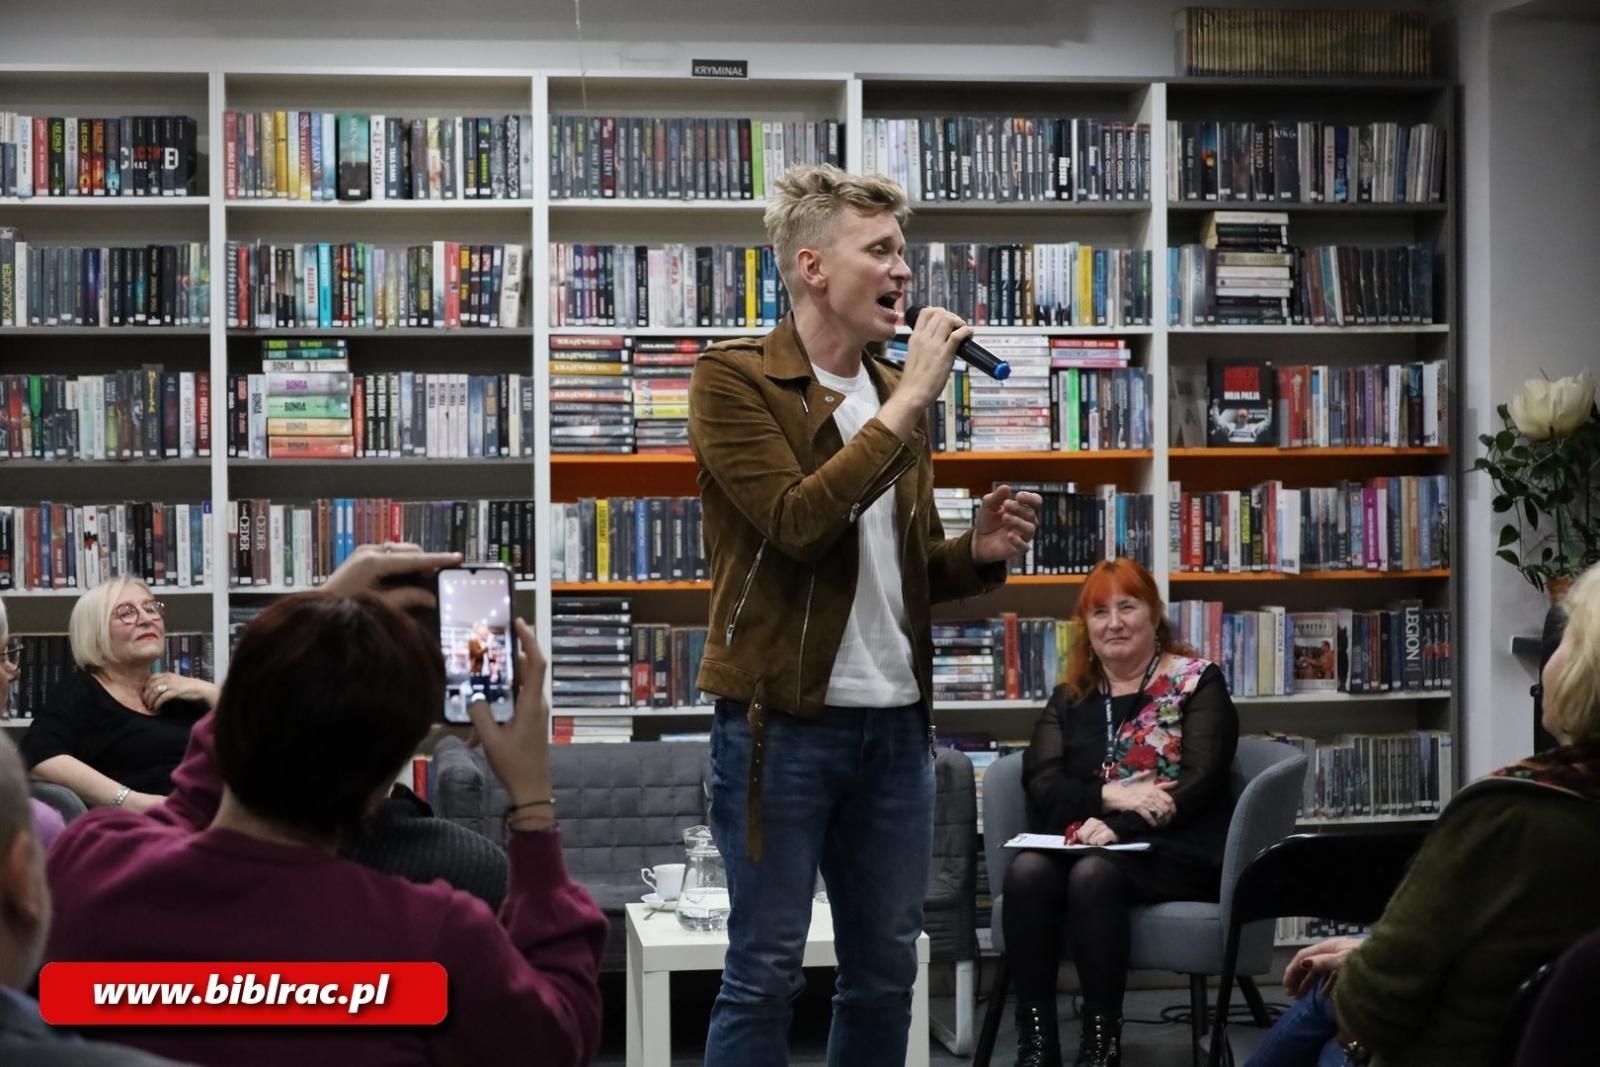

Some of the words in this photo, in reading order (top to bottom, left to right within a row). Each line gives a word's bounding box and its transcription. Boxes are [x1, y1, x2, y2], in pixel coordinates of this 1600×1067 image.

[54, 121, 62, 133] LEE
[54, 134, 62, 153] CHILD
[1255, 131, 1264, 169] CHRISTINE
[604, 148, 613, 176] BLIZNY
[962, 156, 970, 186] NESSER
[1059, 157, 1068, 186] NESSER
[307, 268, 316, 304] BALLADYNA
[200, 396, 208, 423] OPERACJA
[284, 401, 306, 412] BONDA
[1192, 497, 1200, 523] DEKALOG
[239, 516, 250, 552] CEDER
[256, 515, 266, 550] CEDER
[1169, 502, 1180, 553] DZIEKAN
[1405, 606, 1420, 660] LEGION
